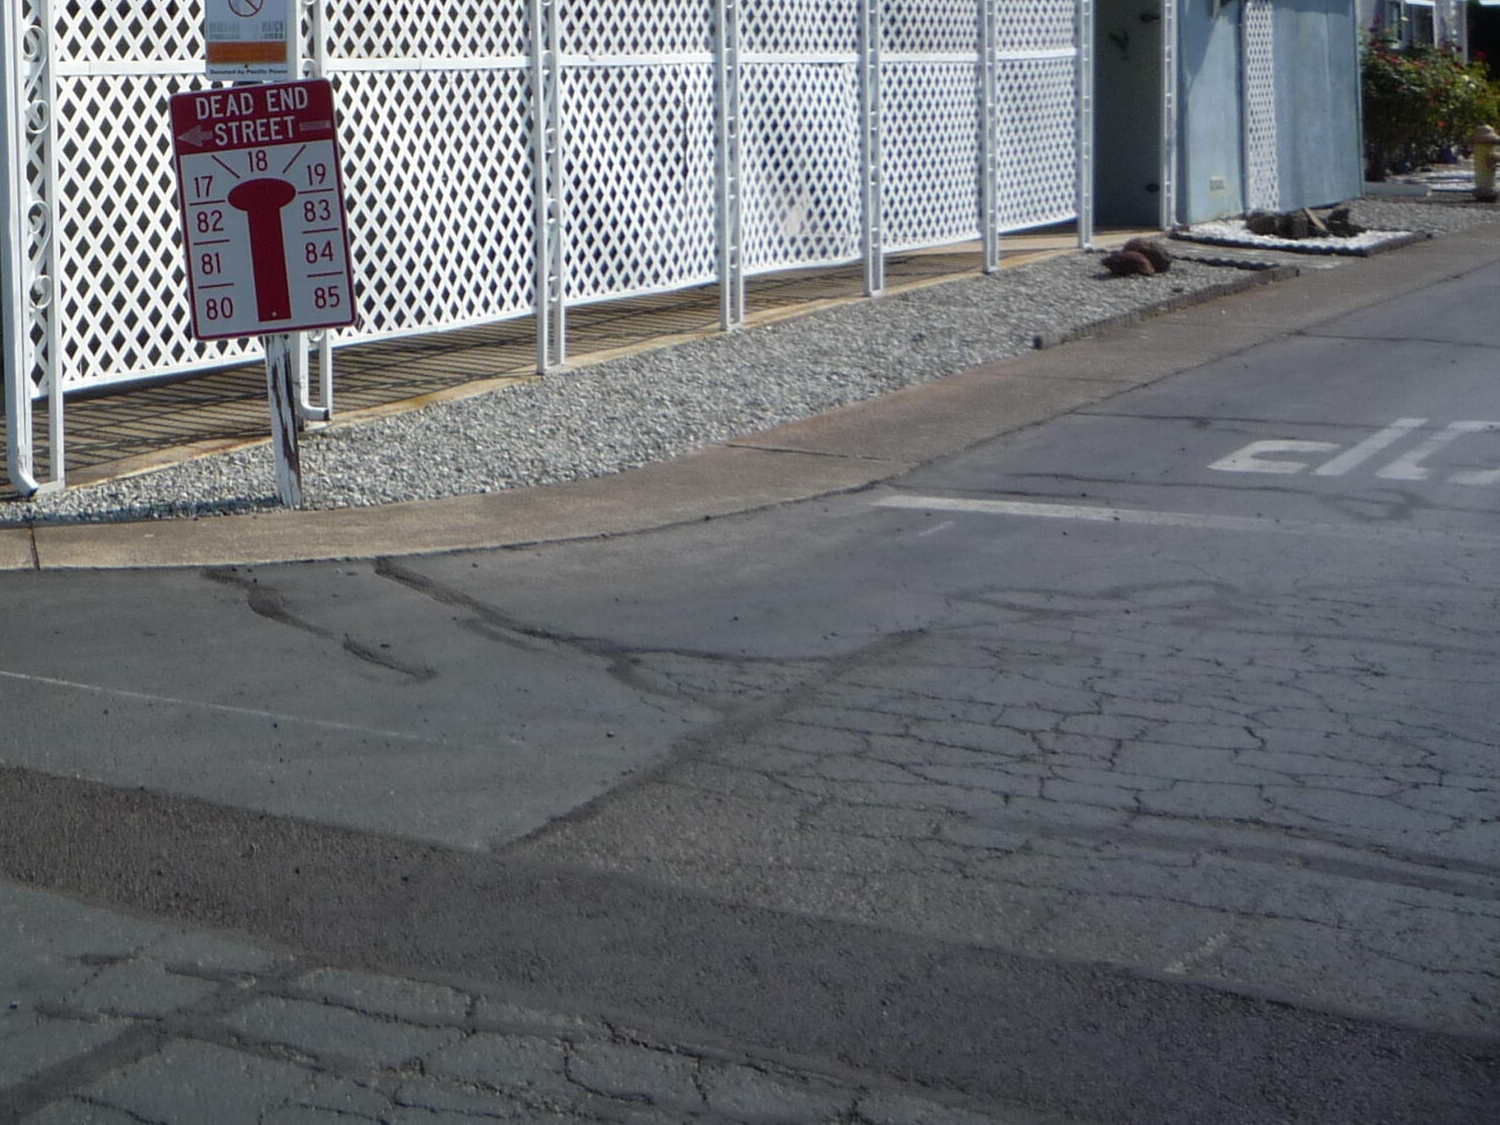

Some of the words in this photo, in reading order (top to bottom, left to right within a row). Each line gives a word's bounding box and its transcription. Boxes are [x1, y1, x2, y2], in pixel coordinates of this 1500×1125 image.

[195, 92, 254, 120] DEAD
[266, 87, 308, 112] END
[214, 115, 295, 146] STREET
[248, 149, 268, 173] 18
[194, 175, 213, 198] 17
[306, 163, 326, 186] 19
[197, 209, 224, 233] 82
[303, 199, 331, 222] 83
[201, 252, 221, 275] 81
[305, 240, 333, 264] 84
[206, 296, 233, 320] 80
[314, 285, 340, 309] 85
